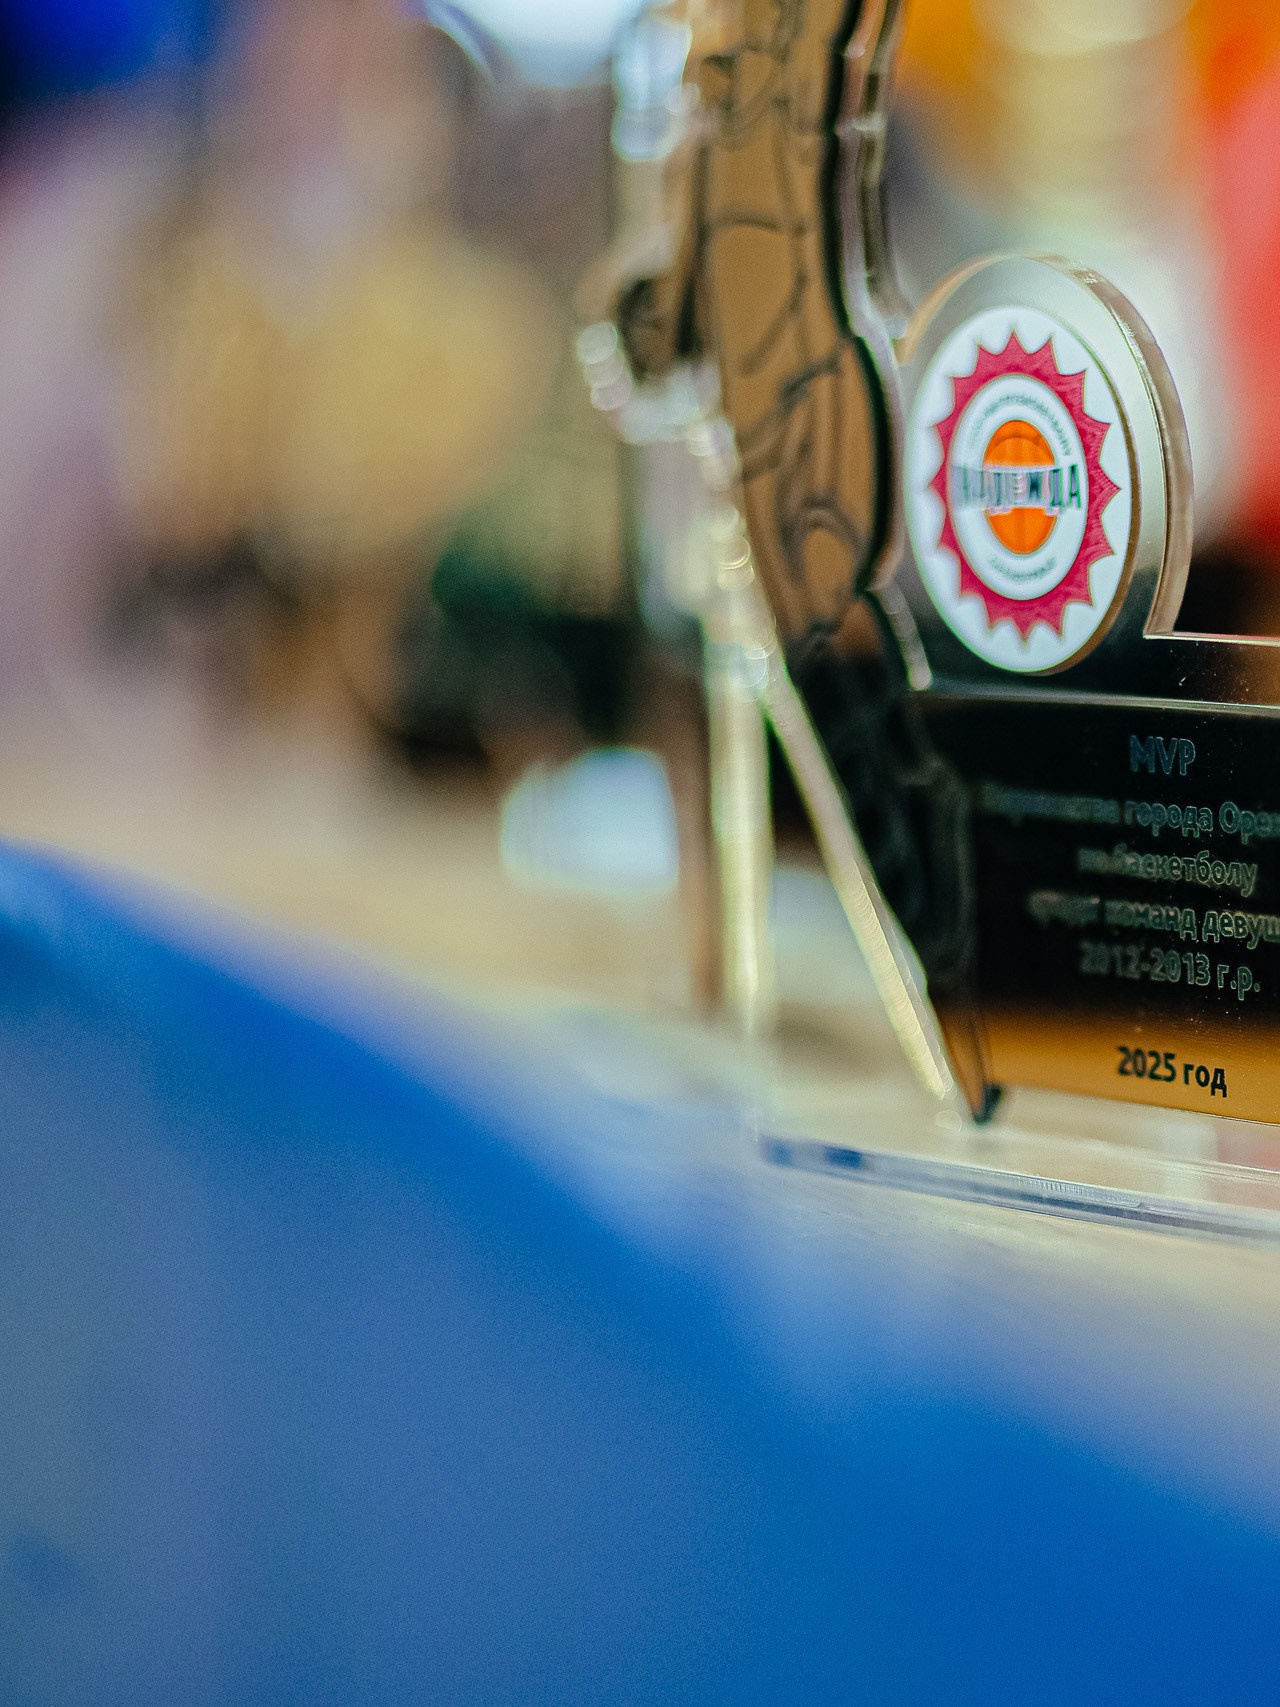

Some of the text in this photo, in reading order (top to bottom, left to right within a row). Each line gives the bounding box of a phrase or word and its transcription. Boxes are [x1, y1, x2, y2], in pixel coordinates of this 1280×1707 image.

[1129, 734, 1197, 776] MVP
[1126, 799, 1213, 839] города
[1112, 841, 1258, 898] баскетболу
[1216, 964, 1261, 1002] г.р.
[1117, 1044, 1228, 1099] 2025 год
